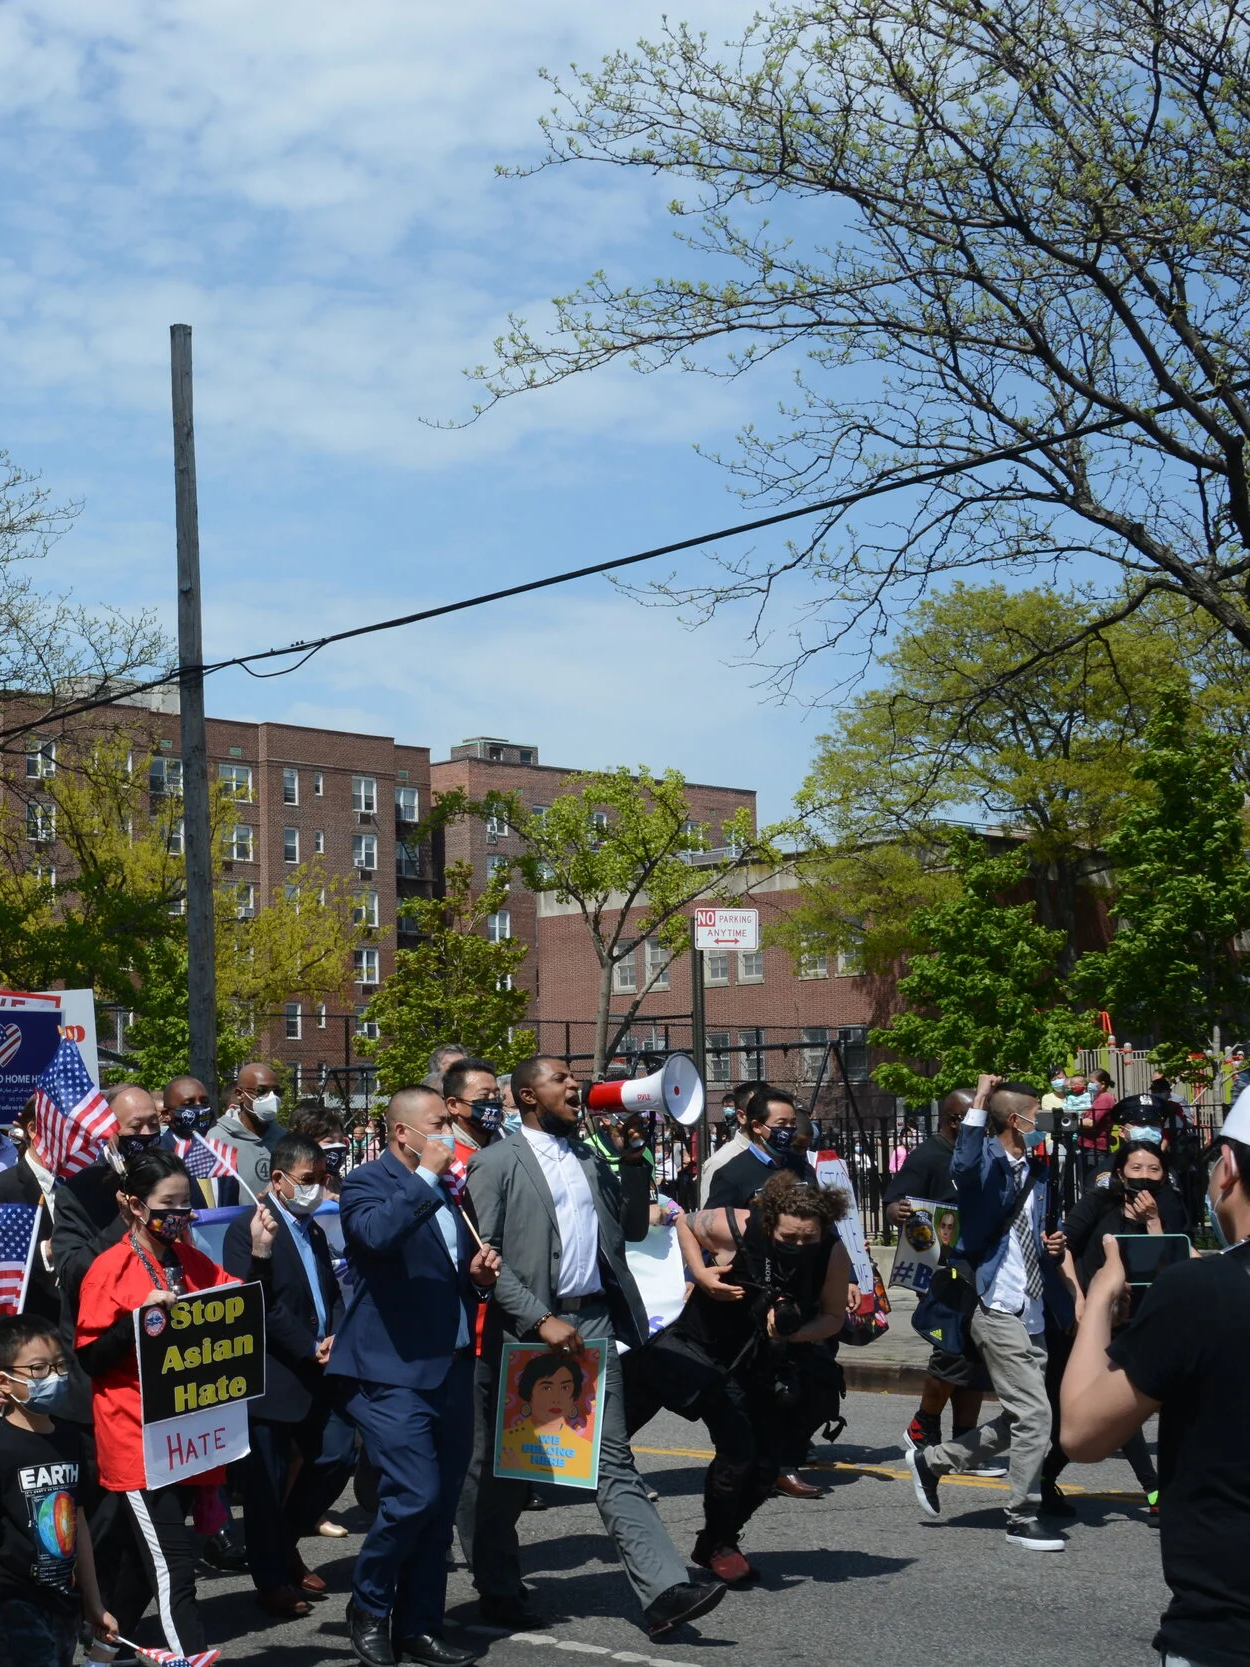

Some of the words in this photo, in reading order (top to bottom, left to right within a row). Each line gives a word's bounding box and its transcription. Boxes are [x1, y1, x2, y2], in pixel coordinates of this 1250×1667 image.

[697, 911, 715, 925] NO
[719, 915, 752, 923] PARKING
[707, 929, 747, 937] ANYTIME
[5, 1074, 30, 1084] HOME
[260, 1162, 269, 1177] 4
[170, 1295, 245, 1330] Stop
[161, 1333, 254, 1375] Asian
[173, 1375, 247, 1413] Hate
[538, 1434, 561, 1445] WE
[166, 1427, 226, 1471] HATE
[521, 1443, 576, 1458] BELONG
[531, 1455, 566, 1468] HERE
[19, 1463, 80, 1490] EARTH
